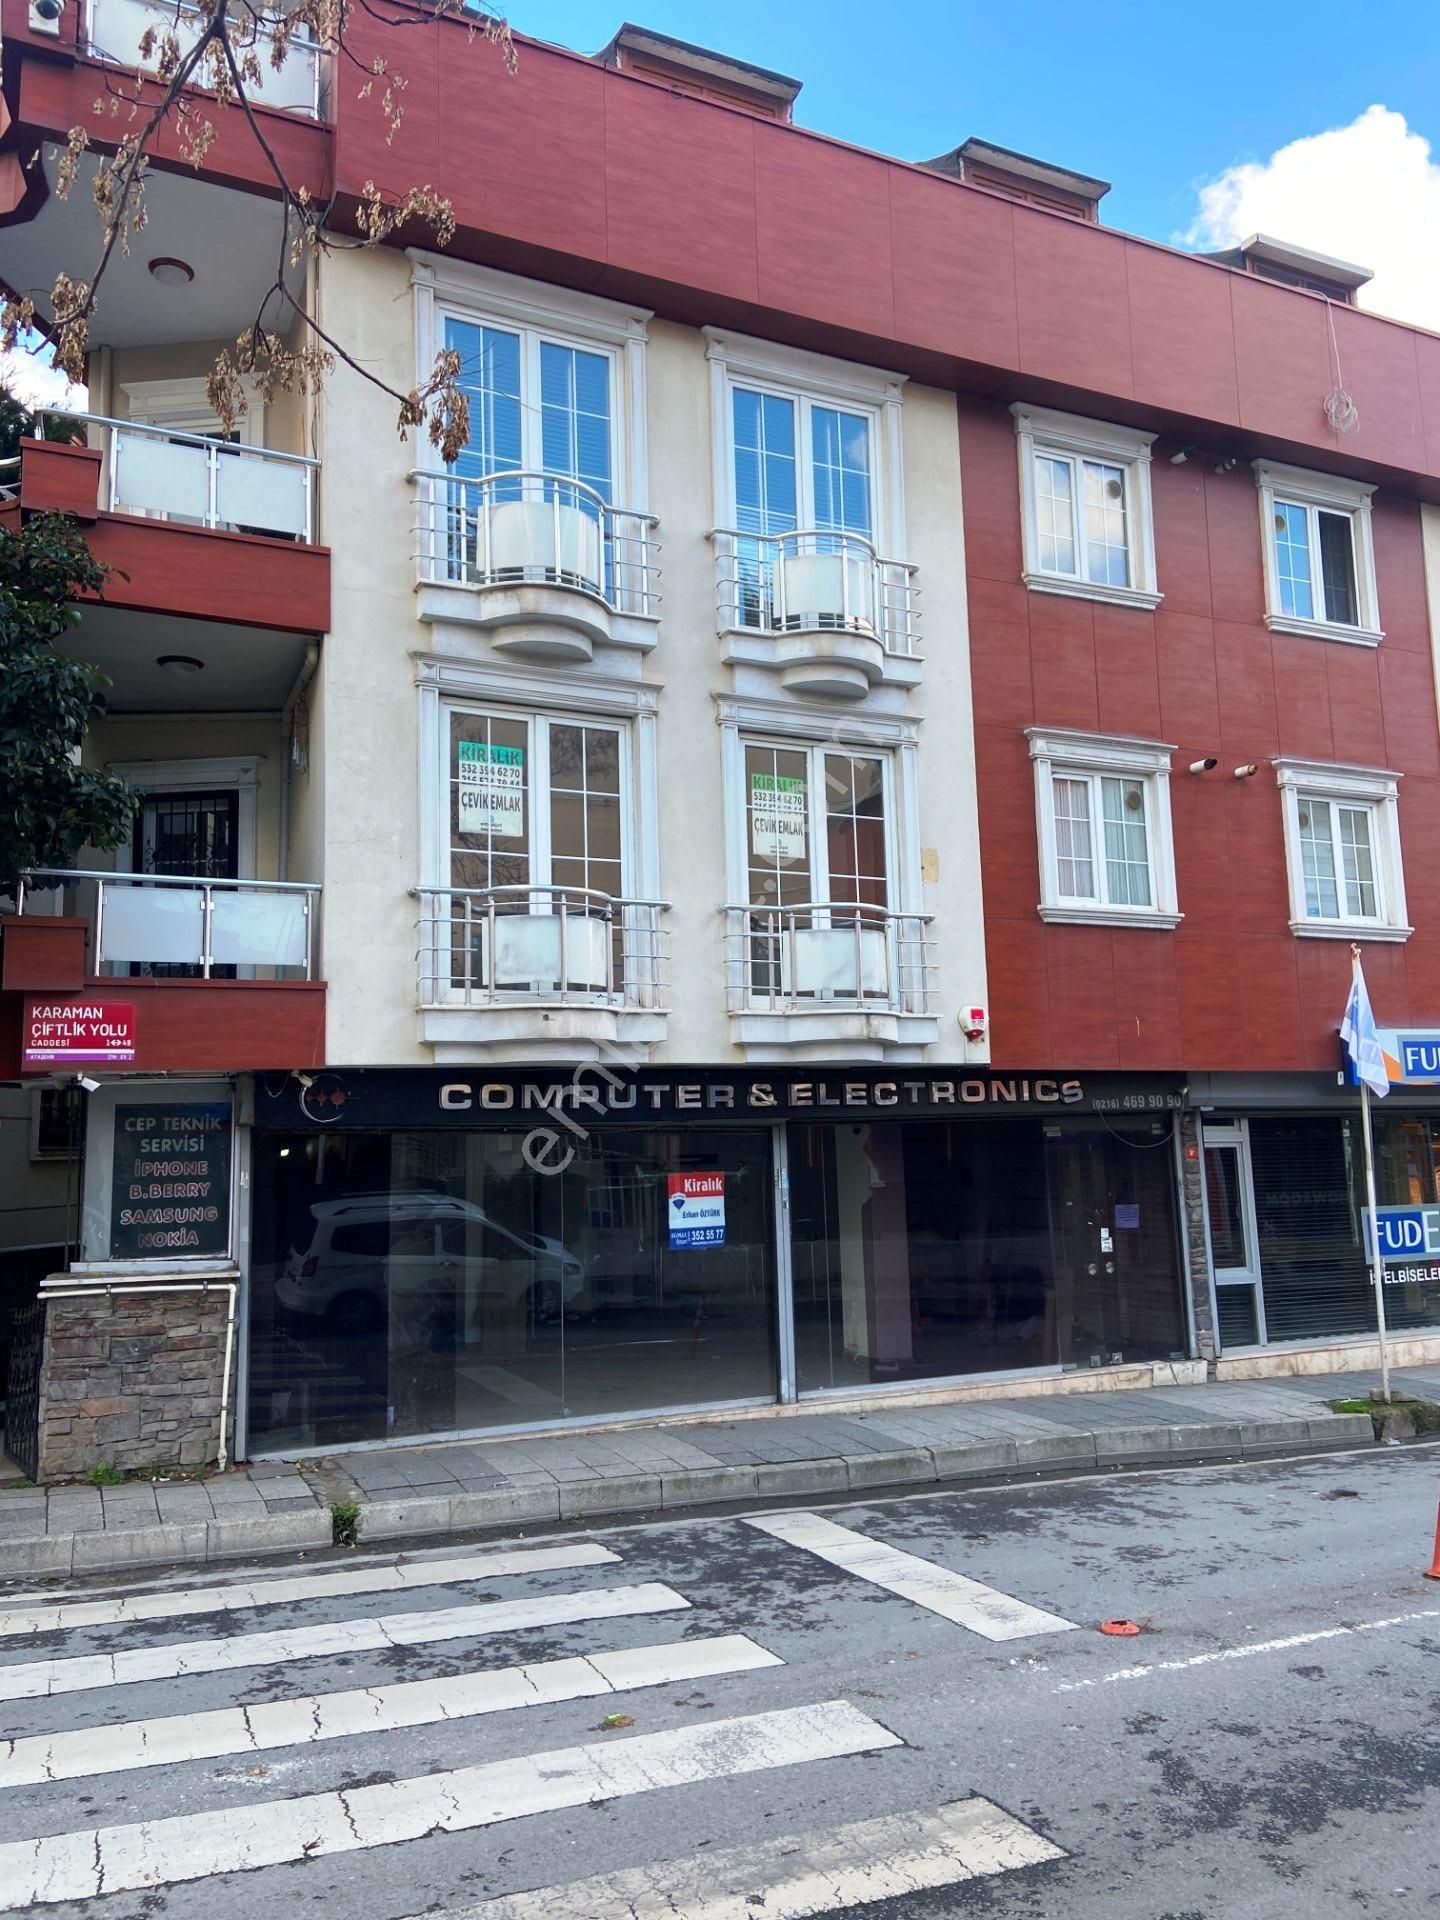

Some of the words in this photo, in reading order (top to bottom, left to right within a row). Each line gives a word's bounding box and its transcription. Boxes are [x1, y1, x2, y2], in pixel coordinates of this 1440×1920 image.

[461, 744, 520, 765] KİRALIK
[461, 763, 477, 774] 532
[497, 767, 508, 777] 62
[509, 768, 520, 779] 70
[461, 789, 488, 811] ÇEVİK
[490, 794, 521, 812] EMLAK
[754, 792, 767, 802] 532
[793, 796, 802, 806] 70
[754, 816, 777, 836] ÇEVİK
[778, 820, 803, 837] EMLAK
[32, 1007, 103, 1019] KARAMAN
[31, 1022, 86, 1037] ÇİFTLİK
[90, 1024, 127, 1036] YOLU
[1406, 1047, 1440, 1071] FU
[440, 1084, 735, 1110] COMPUTER
[749, 1083, 777, 1107] &
[788, 1080, 1084, 1106] ELECTRONICS
[1092, 1099, 1119, 1109] (0216)
[1123, 1096, 1145, 1108] 469
[1148, 1095, 1164, 1107] 90
[124, 1117, 156, 1131] CEP
[162, 1113, 222, 1131] TEKNİK
[140, 1135, 205, 1153] SERVİSİ
[134, 1159, 208, 1177] İPHONE
[130, 1182, 211, 1199] B.BERRY
[685, 1178, 723, 1192] Kiralık
[120, 1206, 218, 1225] SAMSUNG
[700, 1209, 720, 1217] ÖZTÜRK
[138, 1227, 199, 1248] NOKİA
[691, 1230, 705, 1241] 352
[706, 1230, 715, 1240] 55
[715, 1228, 724, 1240] 77
